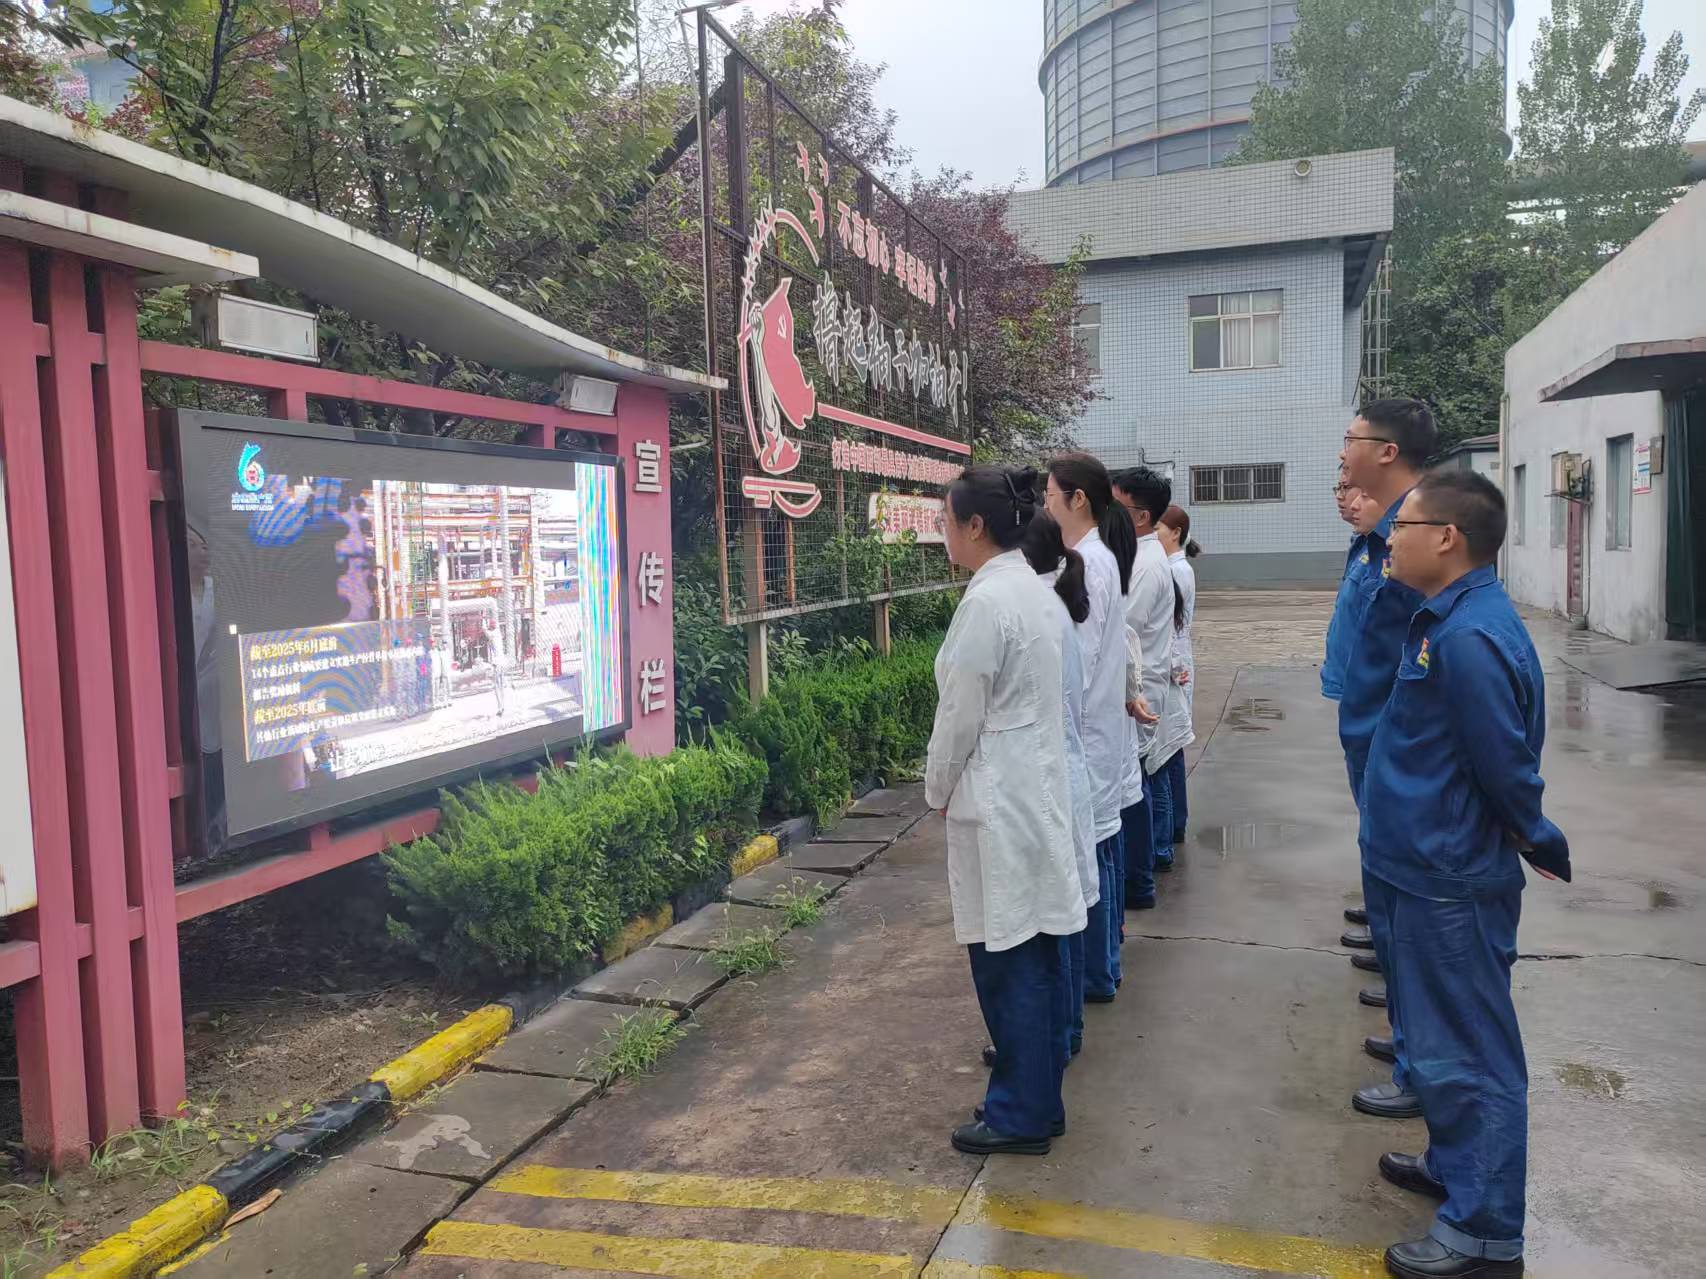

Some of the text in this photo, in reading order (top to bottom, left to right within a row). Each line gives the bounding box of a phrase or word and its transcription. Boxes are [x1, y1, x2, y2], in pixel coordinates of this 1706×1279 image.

[837, 200, 936, 308] 不忘初心 牢记使命
[632, 439, 667, 715] 宣传栏
